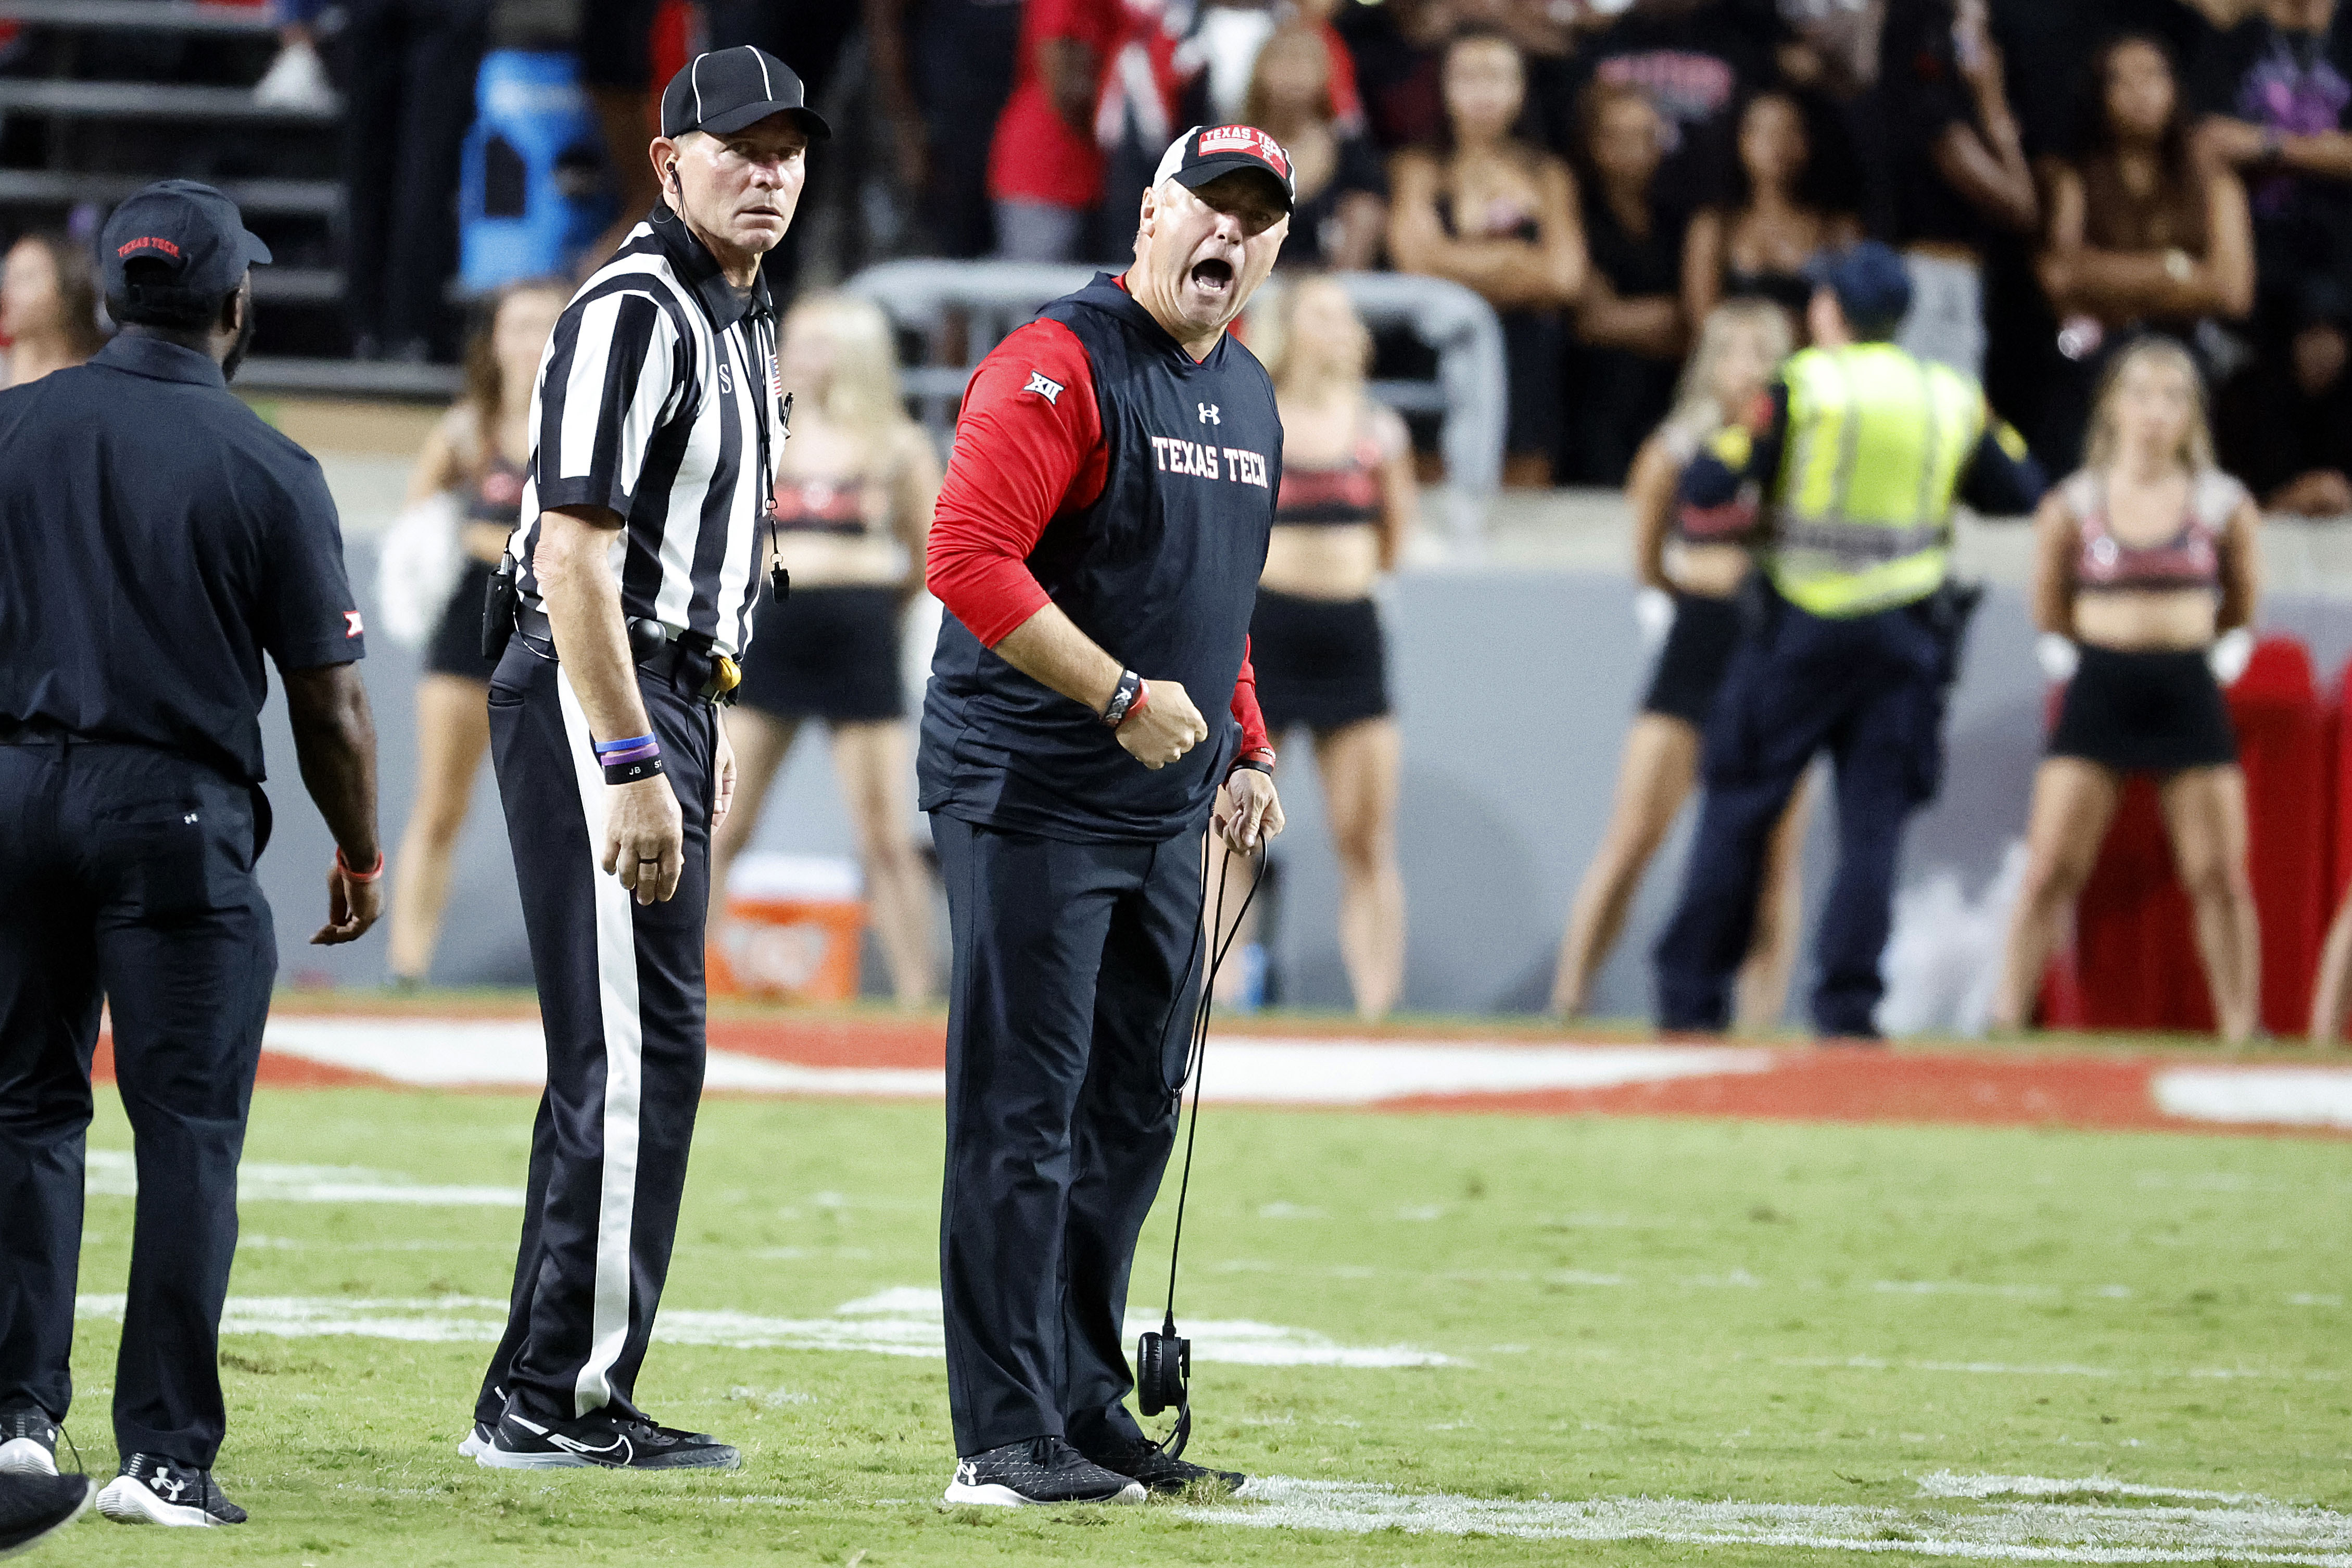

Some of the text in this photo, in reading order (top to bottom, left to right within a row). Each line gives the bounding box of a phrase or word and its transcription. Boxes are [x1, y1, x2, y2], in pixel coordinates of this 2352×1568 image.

[1205, 127, 1286, 163] TEXAS TECH
[1151, 435, 1268, 489] TEXAS TECH
